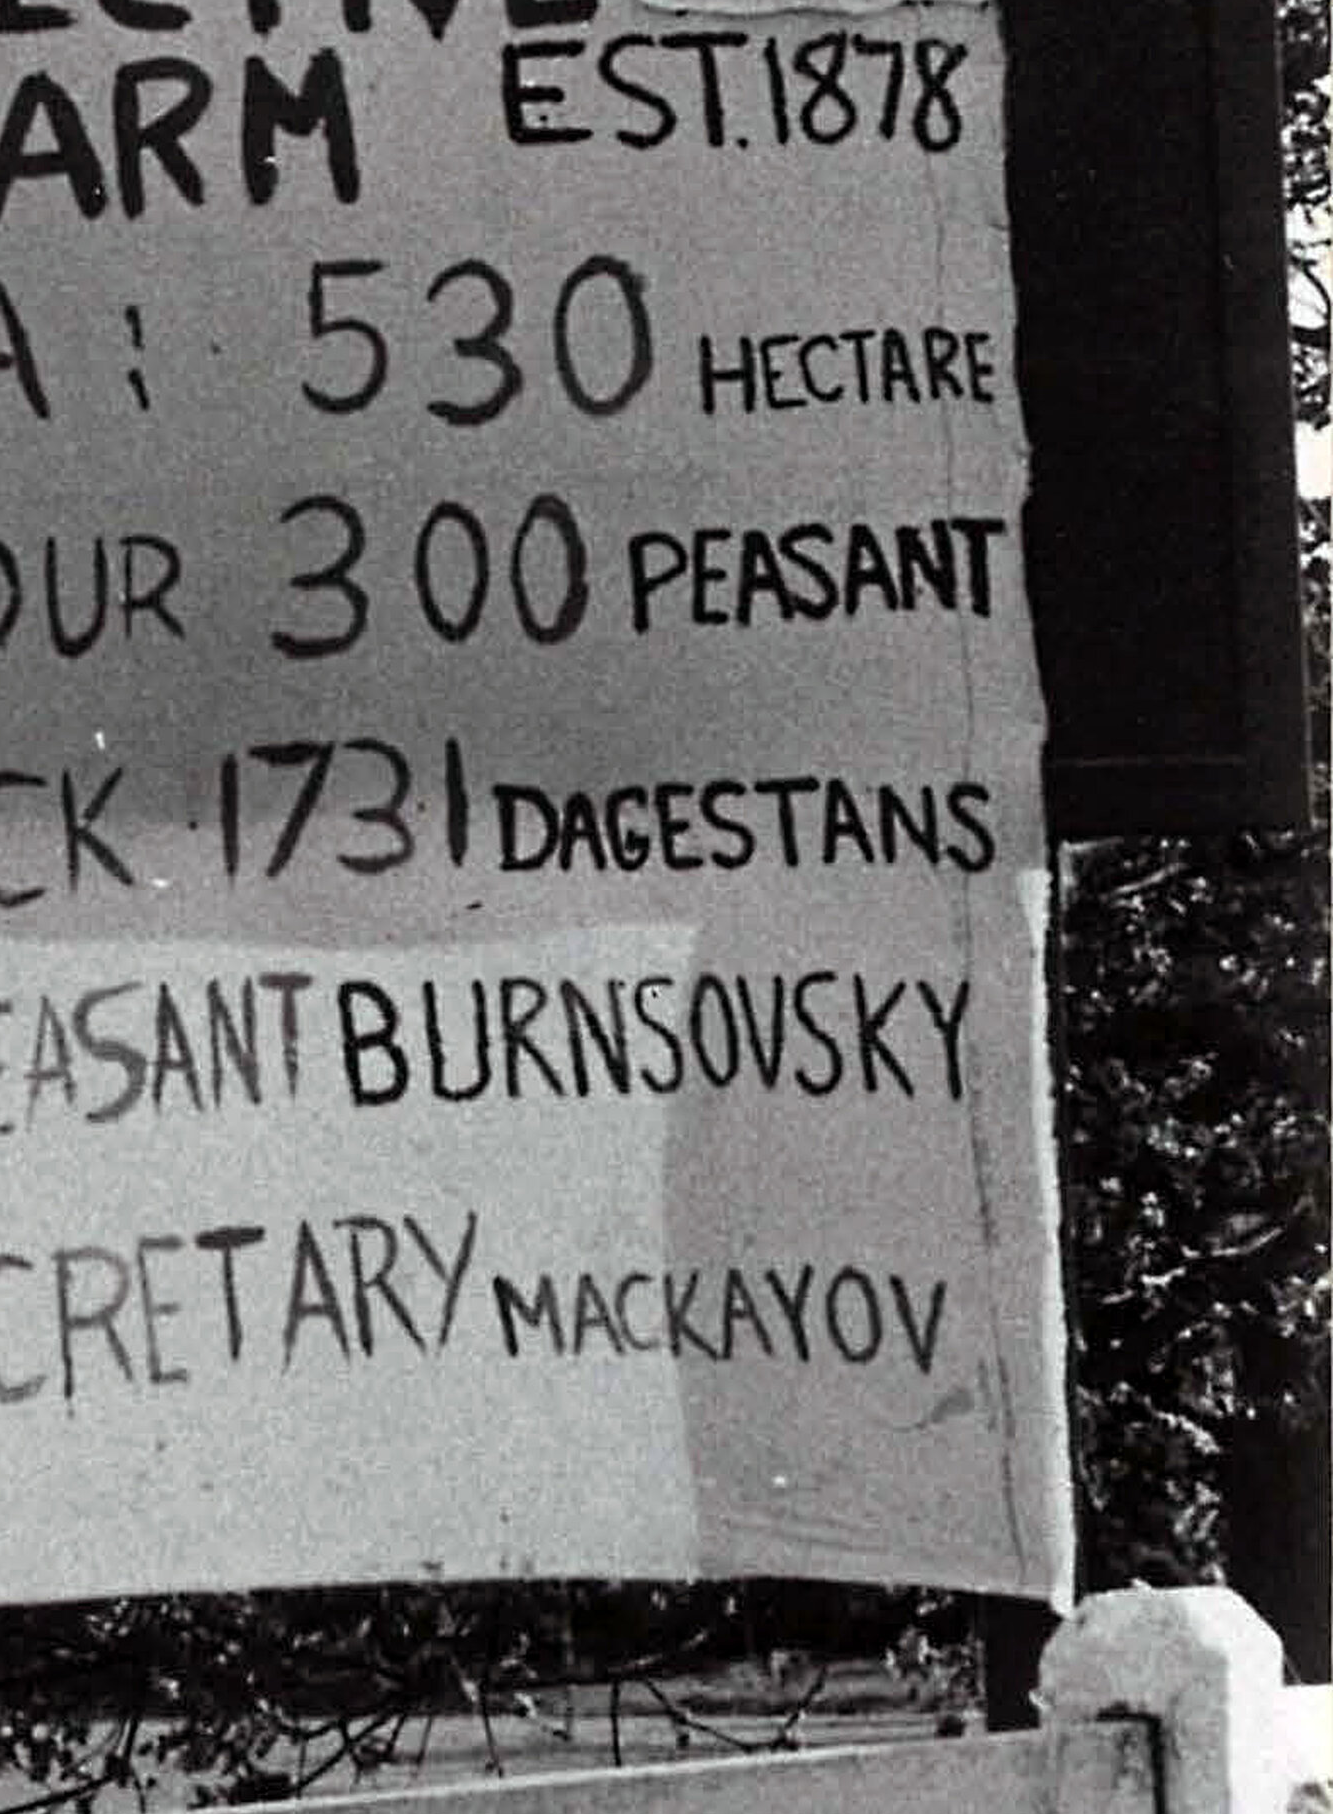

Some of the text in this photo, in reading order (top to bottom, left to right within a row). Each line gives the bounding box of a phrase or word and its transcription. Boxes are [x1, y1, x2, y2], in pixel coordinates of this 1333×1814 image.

[303, 256, 651, 425] 530
[700, 328, 996, 412] HECTARE
[274, 493, 589, 659] 300
[631, 518, 1006, 632] PEASANT
[219, 739, 468, 877] 1731
[498, 780, 994, 874] DAGESTANS
[340, 977, 974, 1109] BURNSOVSKY
[494, 1268, 946, 1372] MACKAYOV
